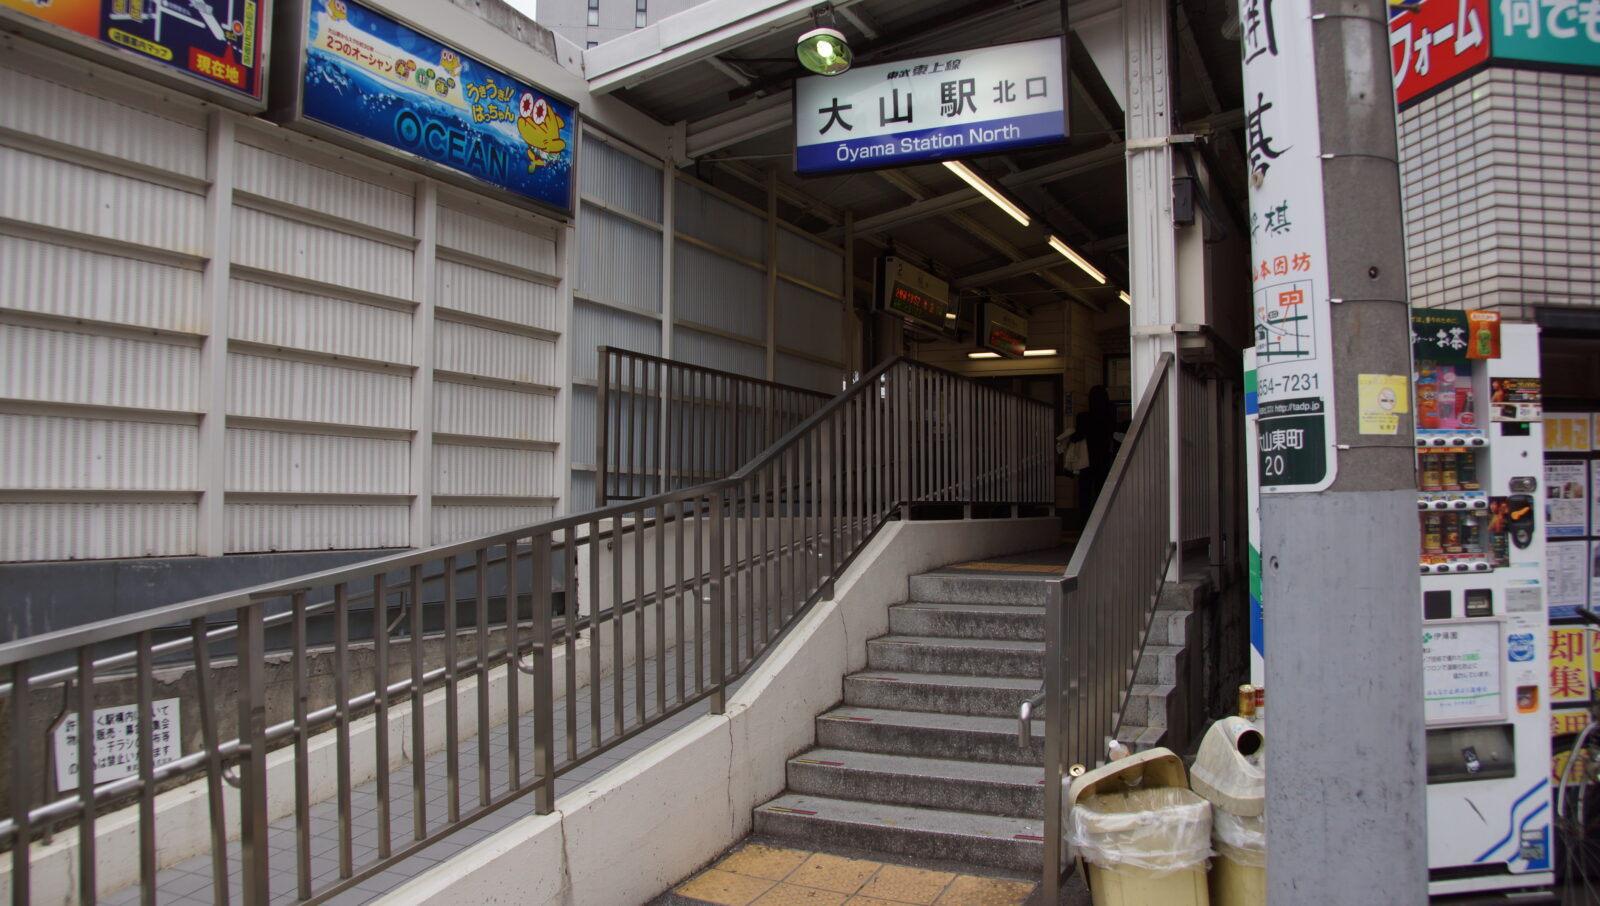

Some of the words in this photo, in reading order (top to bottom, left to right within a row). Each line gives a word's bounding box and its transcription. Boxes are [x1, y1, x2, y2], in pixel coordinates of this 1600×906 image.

[196, 53, 240, 84] 現在地
[326, 35, 393, 73] 2つのオーシャン
[471, 103, 515, 124] はっちゃん
[818, 77, 977, 136] 大山駅
[992, 76, 1048, 105] 北口
[394, 108, 510, 182] OCEAN
[900, 133, 964, 155] Station
[969, 123, 1021, 146] North
[1281, 293, 1301, 305] ココ
[1265, 455, 1284, 476] 20
[1549, 630, 1583, 662] 却
[1550, 665, 1585, 698] 集
